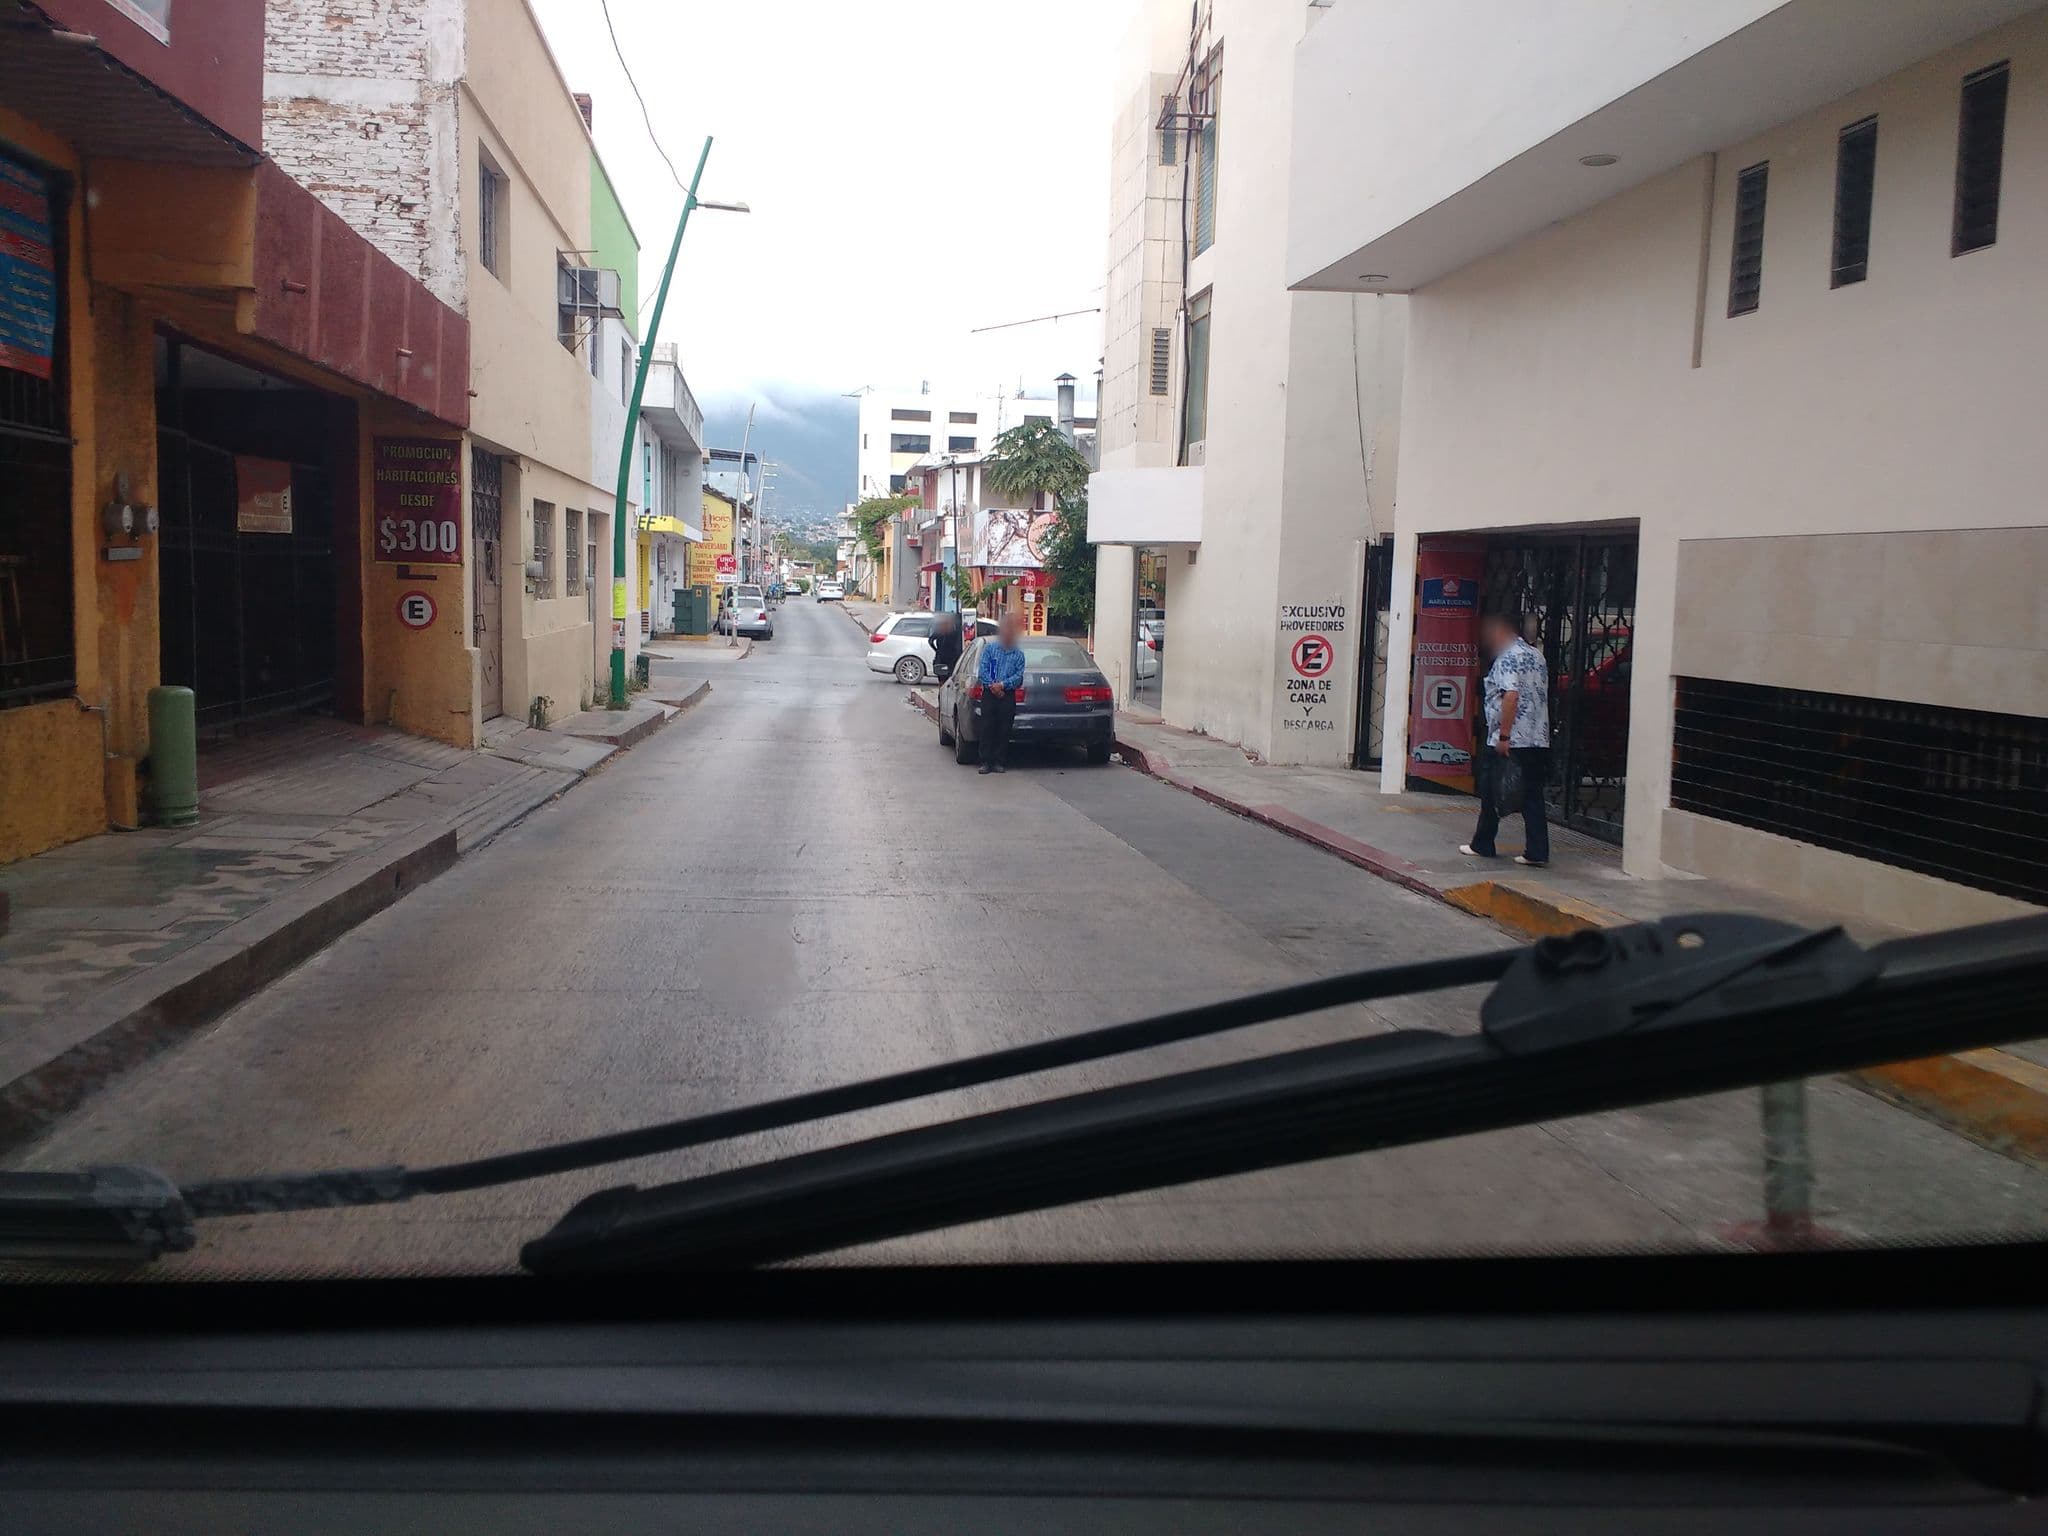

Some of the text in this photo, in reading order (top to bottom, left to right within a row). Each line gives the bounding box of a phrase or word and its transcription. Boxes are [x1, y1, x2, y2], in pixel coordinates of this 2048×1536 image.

[383, 446, 453, 460] PROMOCION
[376, 469, 458, 484] HABITACIONES
[400, 494, 435, 507] DESDE
[379, 516, 457, 554] $300
[408, 600, 424, 619] E
[1281, 605, 1346, 618] EXCLUSIVO
[1280, 620, 1345, 632] PROVEEDORES
[1417, 642, 1477, 653] EXCLUSIVO
[1287, 679, 1332, 691] ZONA DE
[1290, 693, 1327, 704] CARGA
[1436, 687, 1452, 707] E
[1303, 706, 1313, 717] Y
[1283, 719, 1334, 731] DESCARGA
